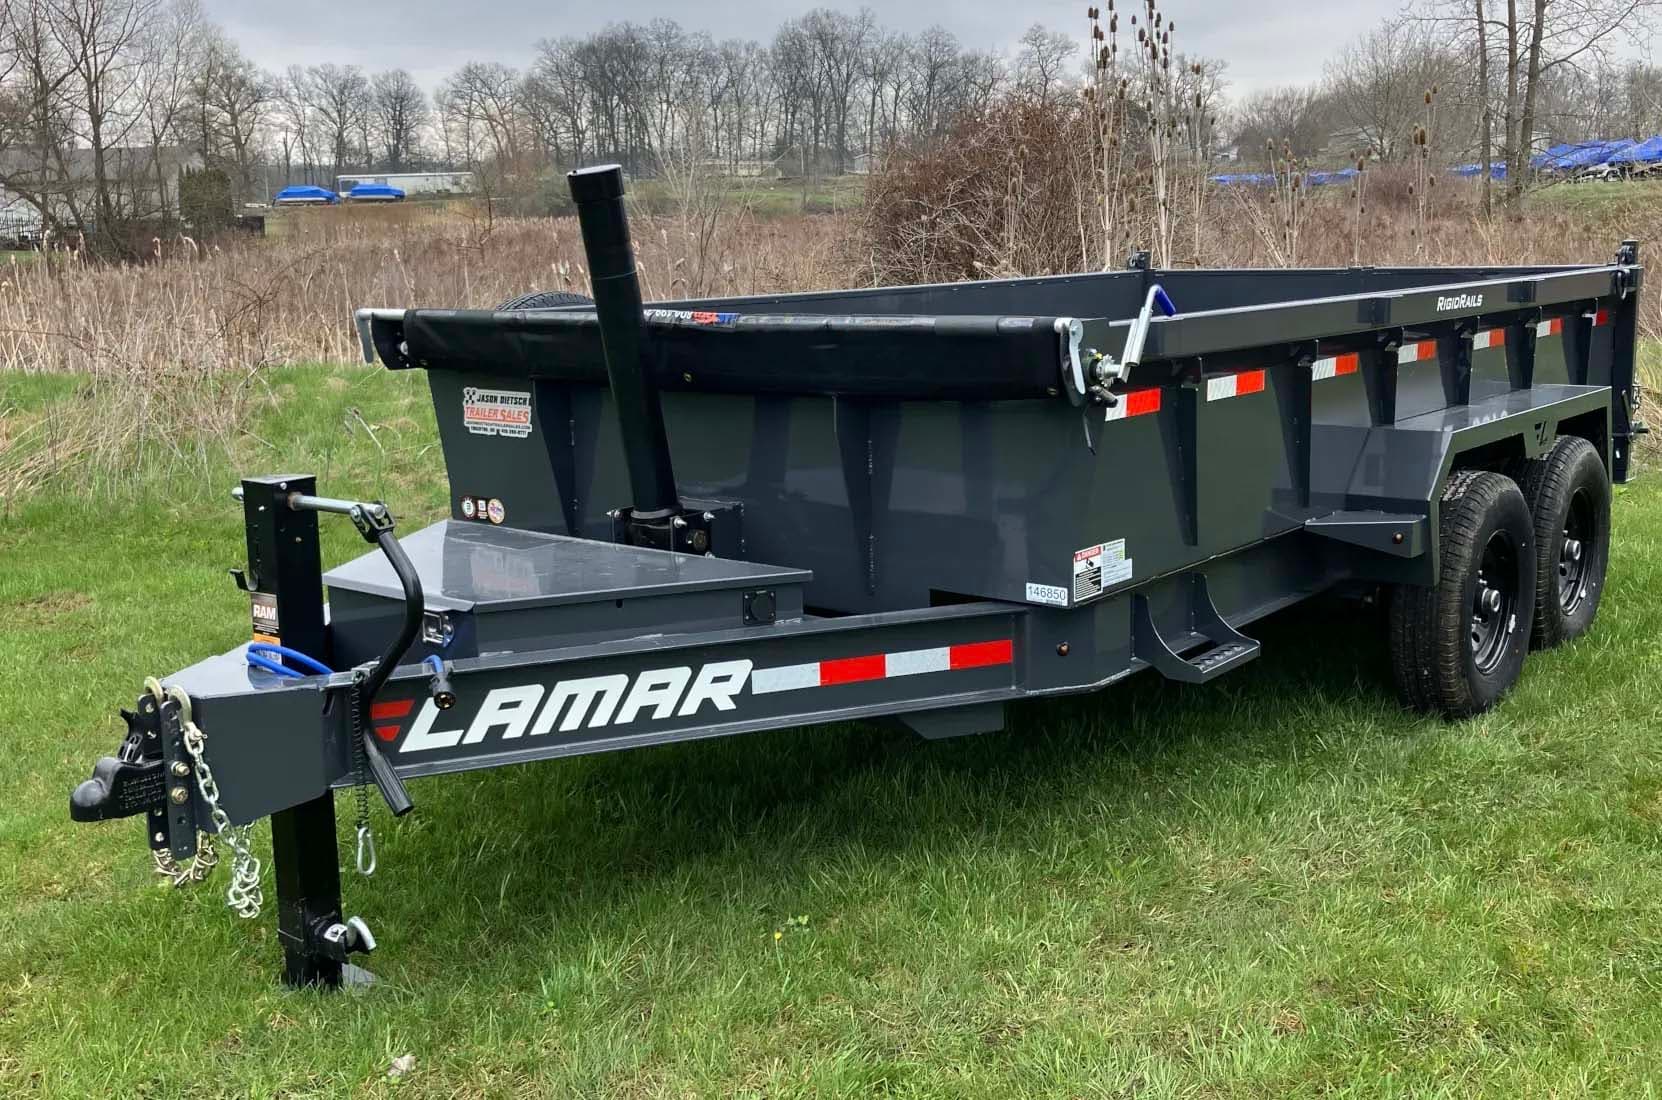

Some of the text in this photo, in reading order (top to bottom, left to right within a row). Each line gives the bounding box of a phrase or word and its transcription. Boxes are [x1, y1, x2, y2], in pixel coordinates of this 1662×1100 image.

[477, 394, 528, 406] JASON DIETSCH
[466, 406, 529, 423] TRAILER SALES
[1028, 586, 1067, 601] 146850
[253, 604, 276, 620] RAM
[400, 659, 753, 753] LAMAR
